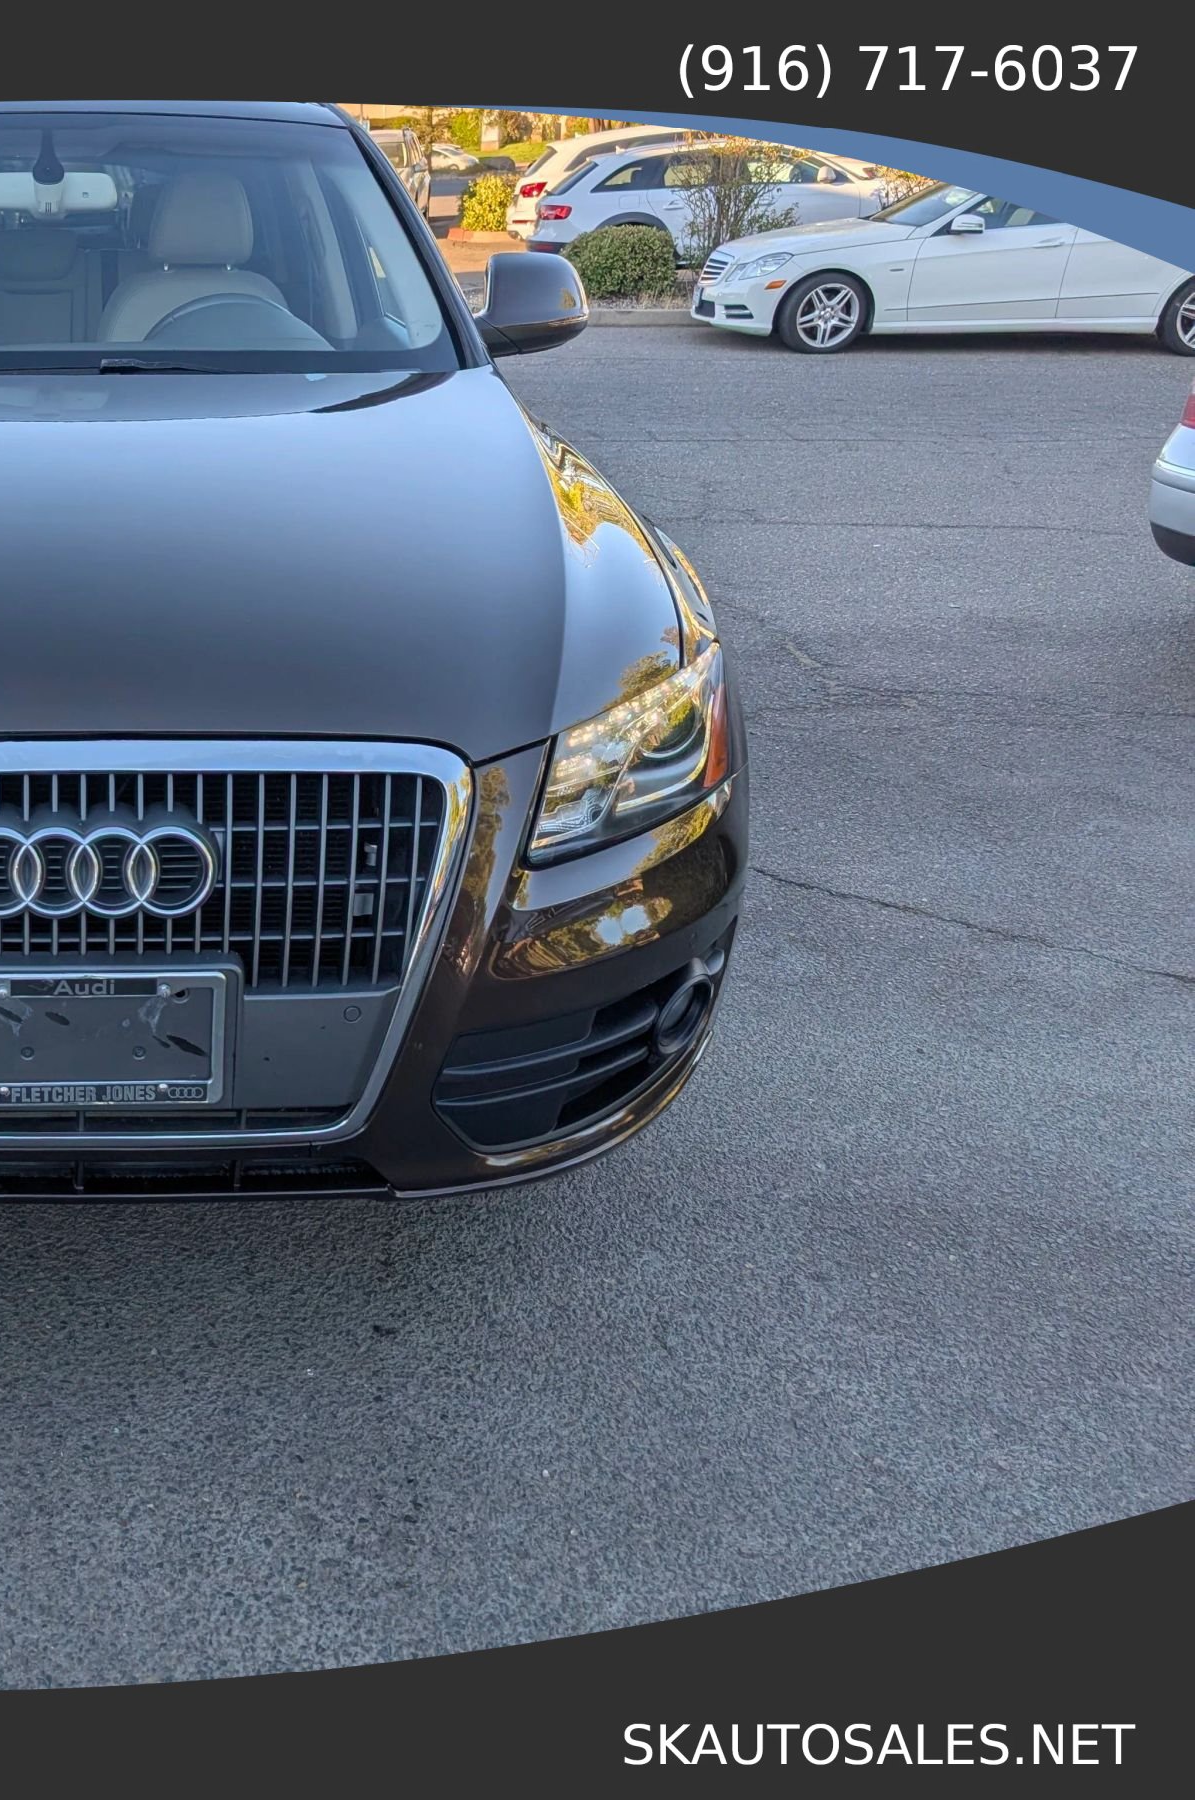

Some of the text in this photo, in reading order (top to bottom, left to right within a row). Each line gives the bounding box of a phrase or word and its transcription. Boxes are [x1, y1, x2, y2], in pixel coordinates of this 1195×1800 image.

[53, 979, 116, 996] Audi
[10, 1085, 156, 1102] FLETCHER JONES
